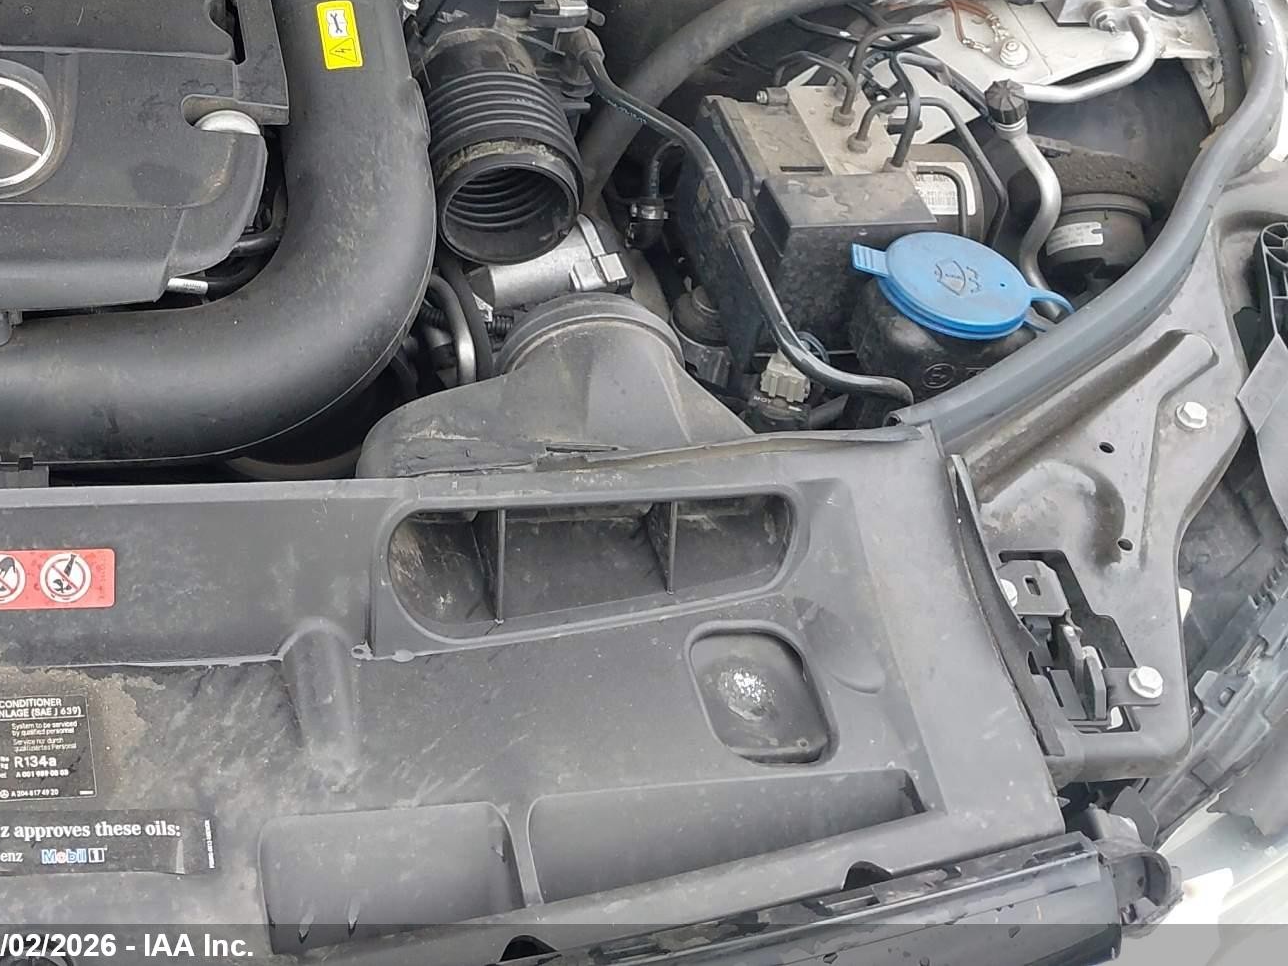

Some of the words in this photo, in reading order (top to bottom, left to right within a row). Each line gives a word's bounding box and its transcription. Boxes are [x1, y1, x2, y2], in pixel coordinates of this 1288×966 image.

[31, 708, 51, 718] (SAE
[60, 706, 81, 715] 639)
[14, 756, 57, 768] R134a
[14, 825, 90, 841] approves
[95, 821, 141, 836] these
[145, 820, 181, 837] oils:
[41, 848, 88, 864] Mobil
